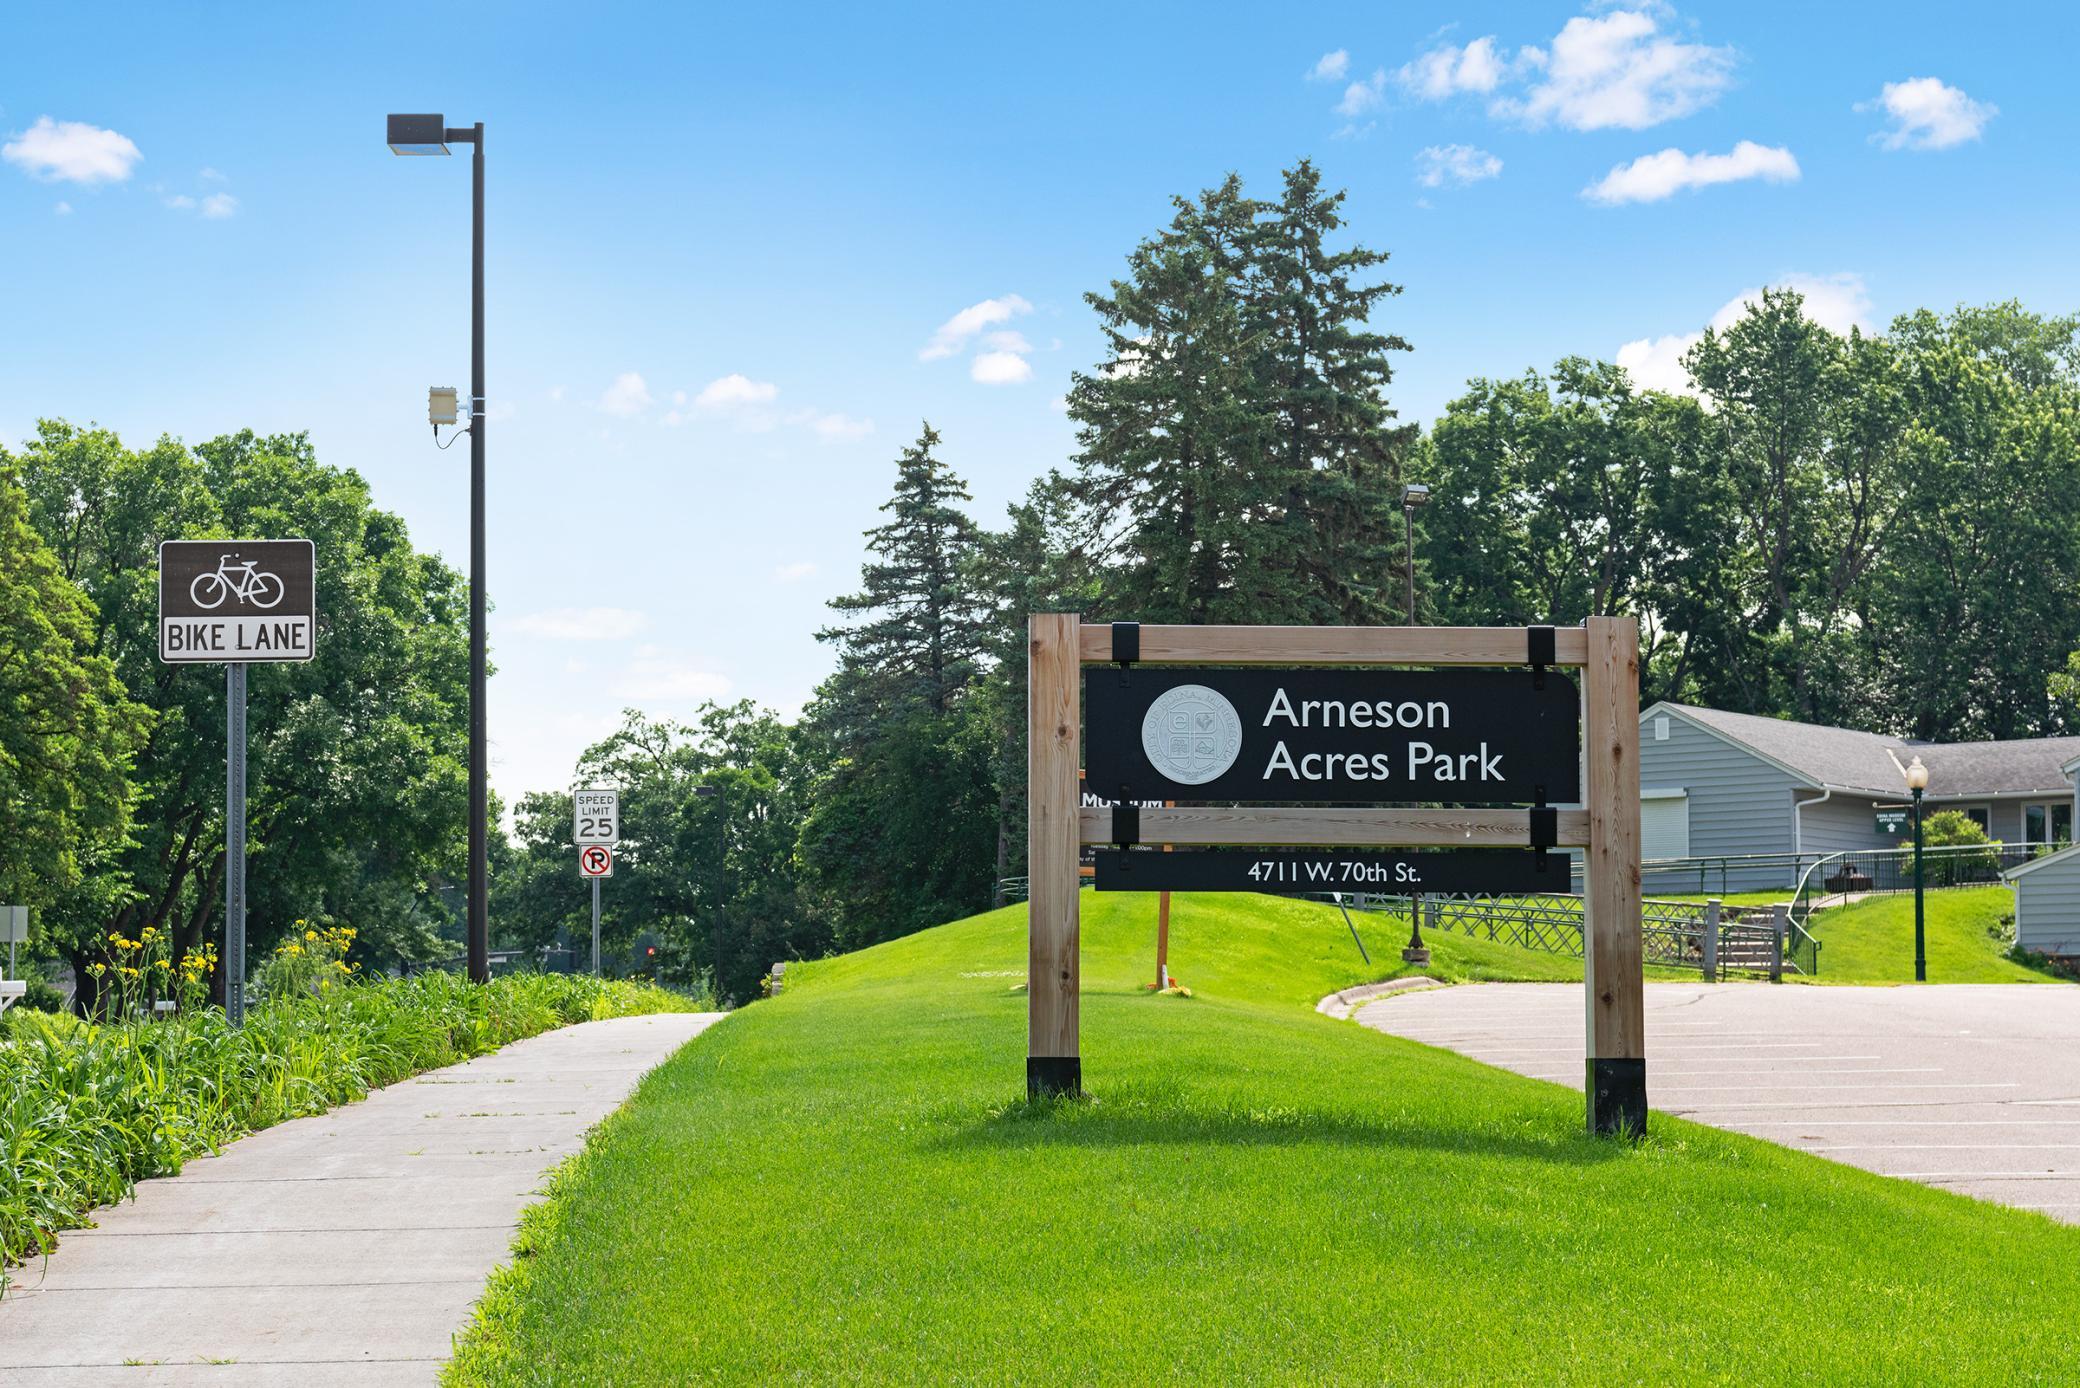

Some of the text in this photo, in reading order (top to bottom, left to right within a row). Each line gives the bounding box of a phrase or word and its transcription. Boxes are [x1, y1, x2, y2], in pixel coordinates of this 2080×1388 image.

[168, 623, 306, 651] BIKE LANE
[1262, 688, 1450, 729] Arneson
[1262, 741, 1506, 782] Acres Park
[578, 796, 614, 805] SPEED
[582, 807, 610, 816] LIMIT
[580, 818, 613, 837] 25
[1247, 861, 1422, 882] 4711 W. 70th St.
